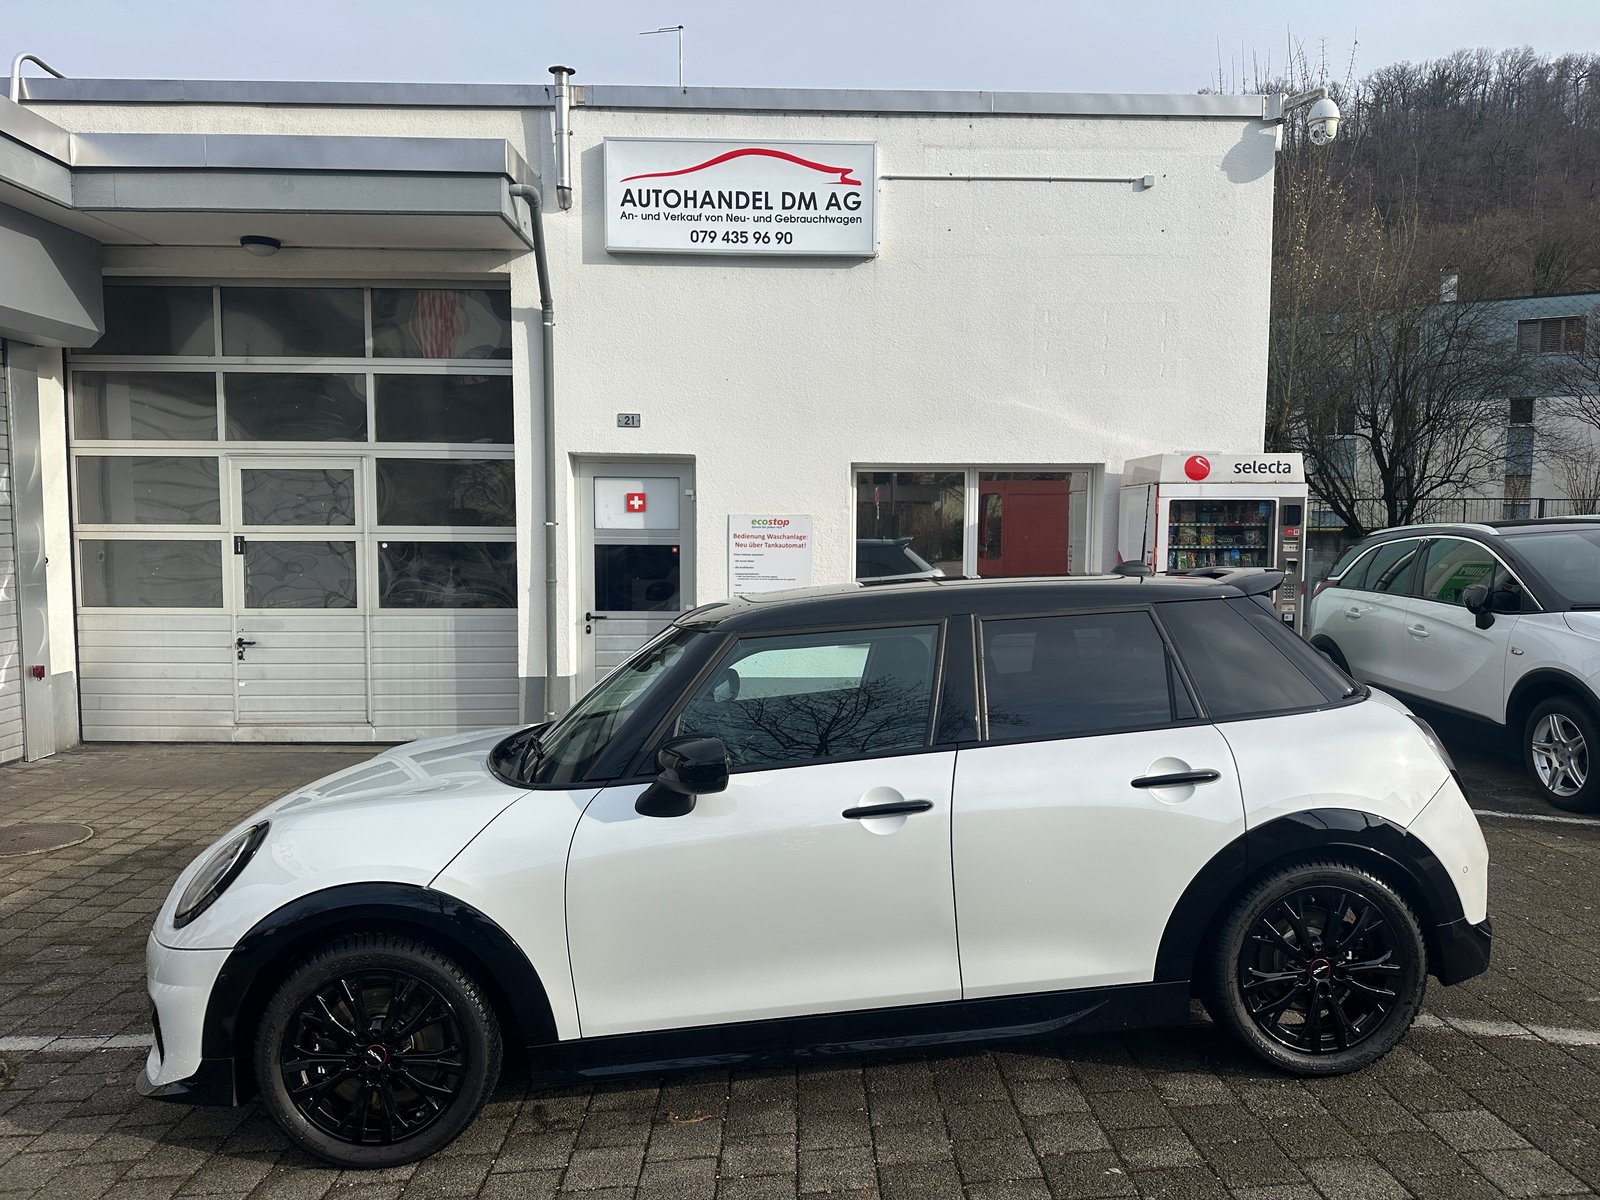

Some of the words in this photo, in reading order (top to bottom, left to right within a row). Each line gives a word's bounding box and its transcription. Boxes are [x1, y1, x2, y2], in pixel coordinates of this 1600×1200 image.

[620, 188, 773, 210] AUTOHANDEL
[781, 192, 818, 210] DM
[825, 192, 862, 211] AG
[620, 212, 638, 220] An-
[641, 212, 661, 221] und
[664, 212, 702, 222] Verkauf
[726, 214, 750, 223] Neu-
[753, 215, 772, 223] und
[774, 215, 862, 225] Gebrauchtwagen
[690, 230, 717, 243] 079
[721, 231, 749, 244] 435
[752, 232, 771, 244] 96
[775, 232, 793, 245] 90
[624, 415, 635, 426] 21
[1233, 460, 1292, 474] selecta
[751, 518, 790, 527] ecostop
